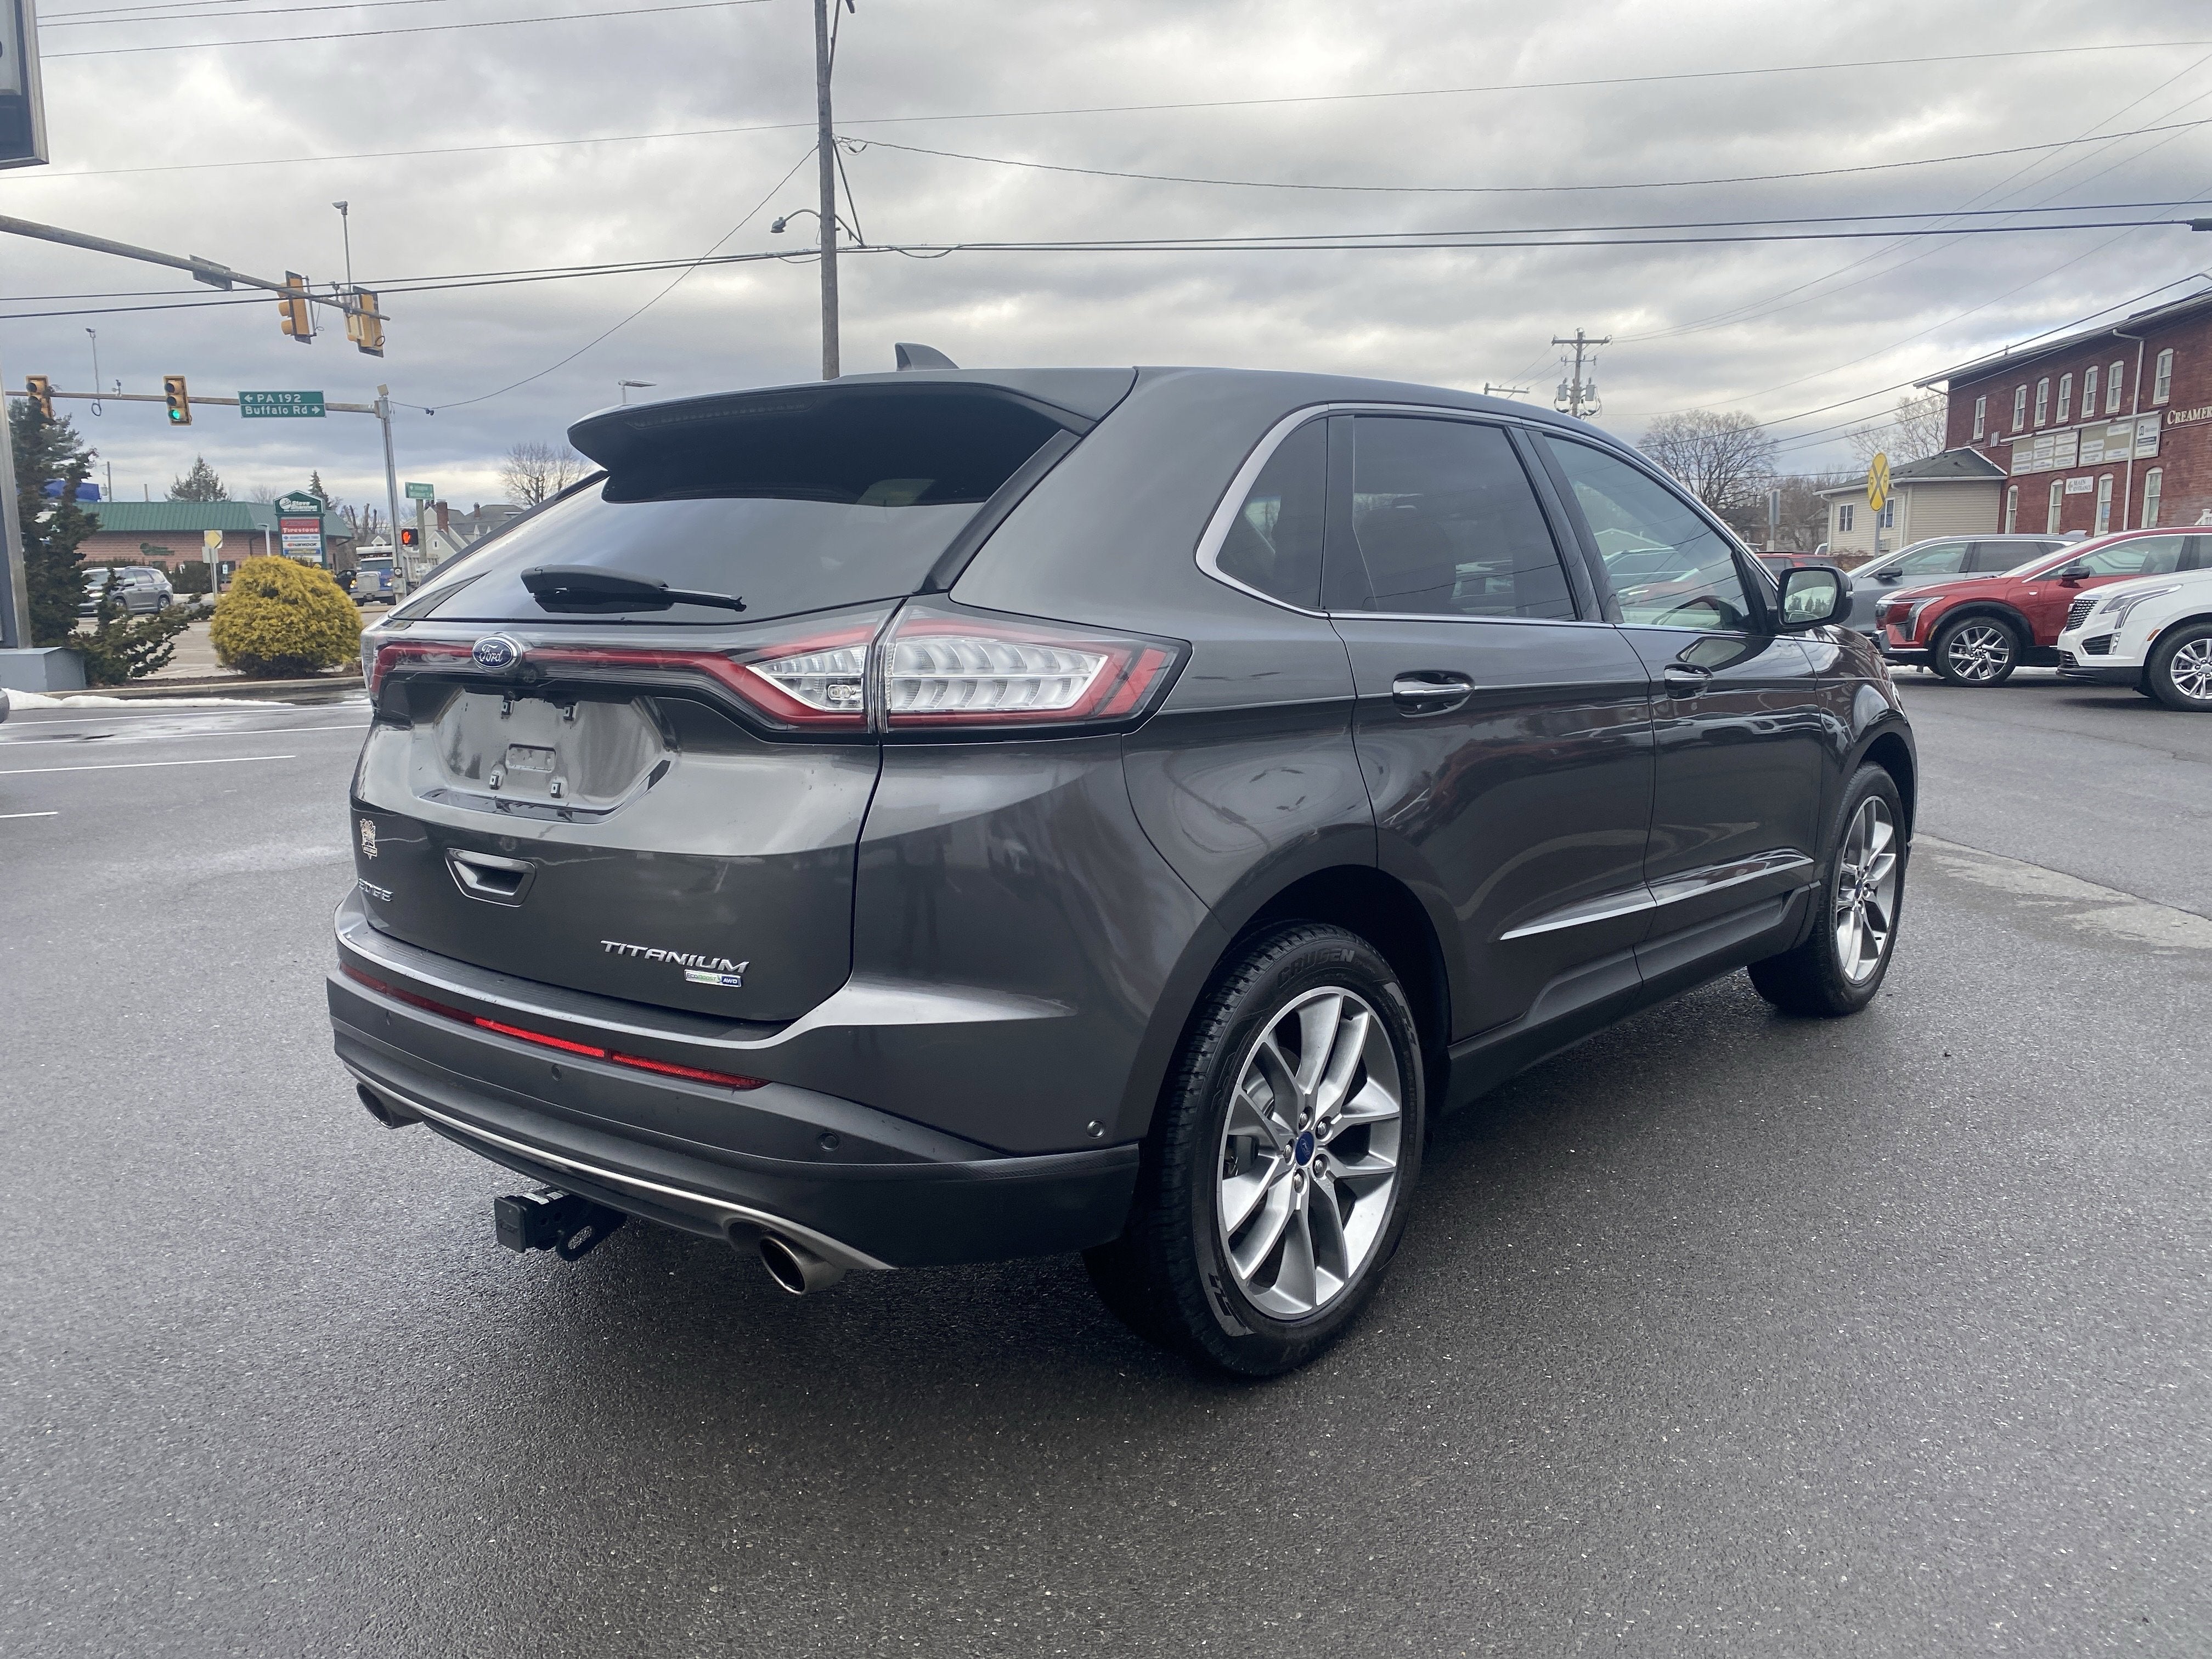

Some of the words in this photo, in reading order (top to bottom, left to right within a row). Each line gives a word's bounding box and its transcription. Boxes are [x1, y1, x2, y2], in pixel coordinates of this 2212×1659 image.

[257, 394, 274, 403] PA
[278, 394, 301, 403] 192
[245, 406, 289, 415] Buffalo
[293, 405, 308, 414] Rd
[479, 644, 505, 662] Ford
[601, 940, 750, 973] TITANIUM
